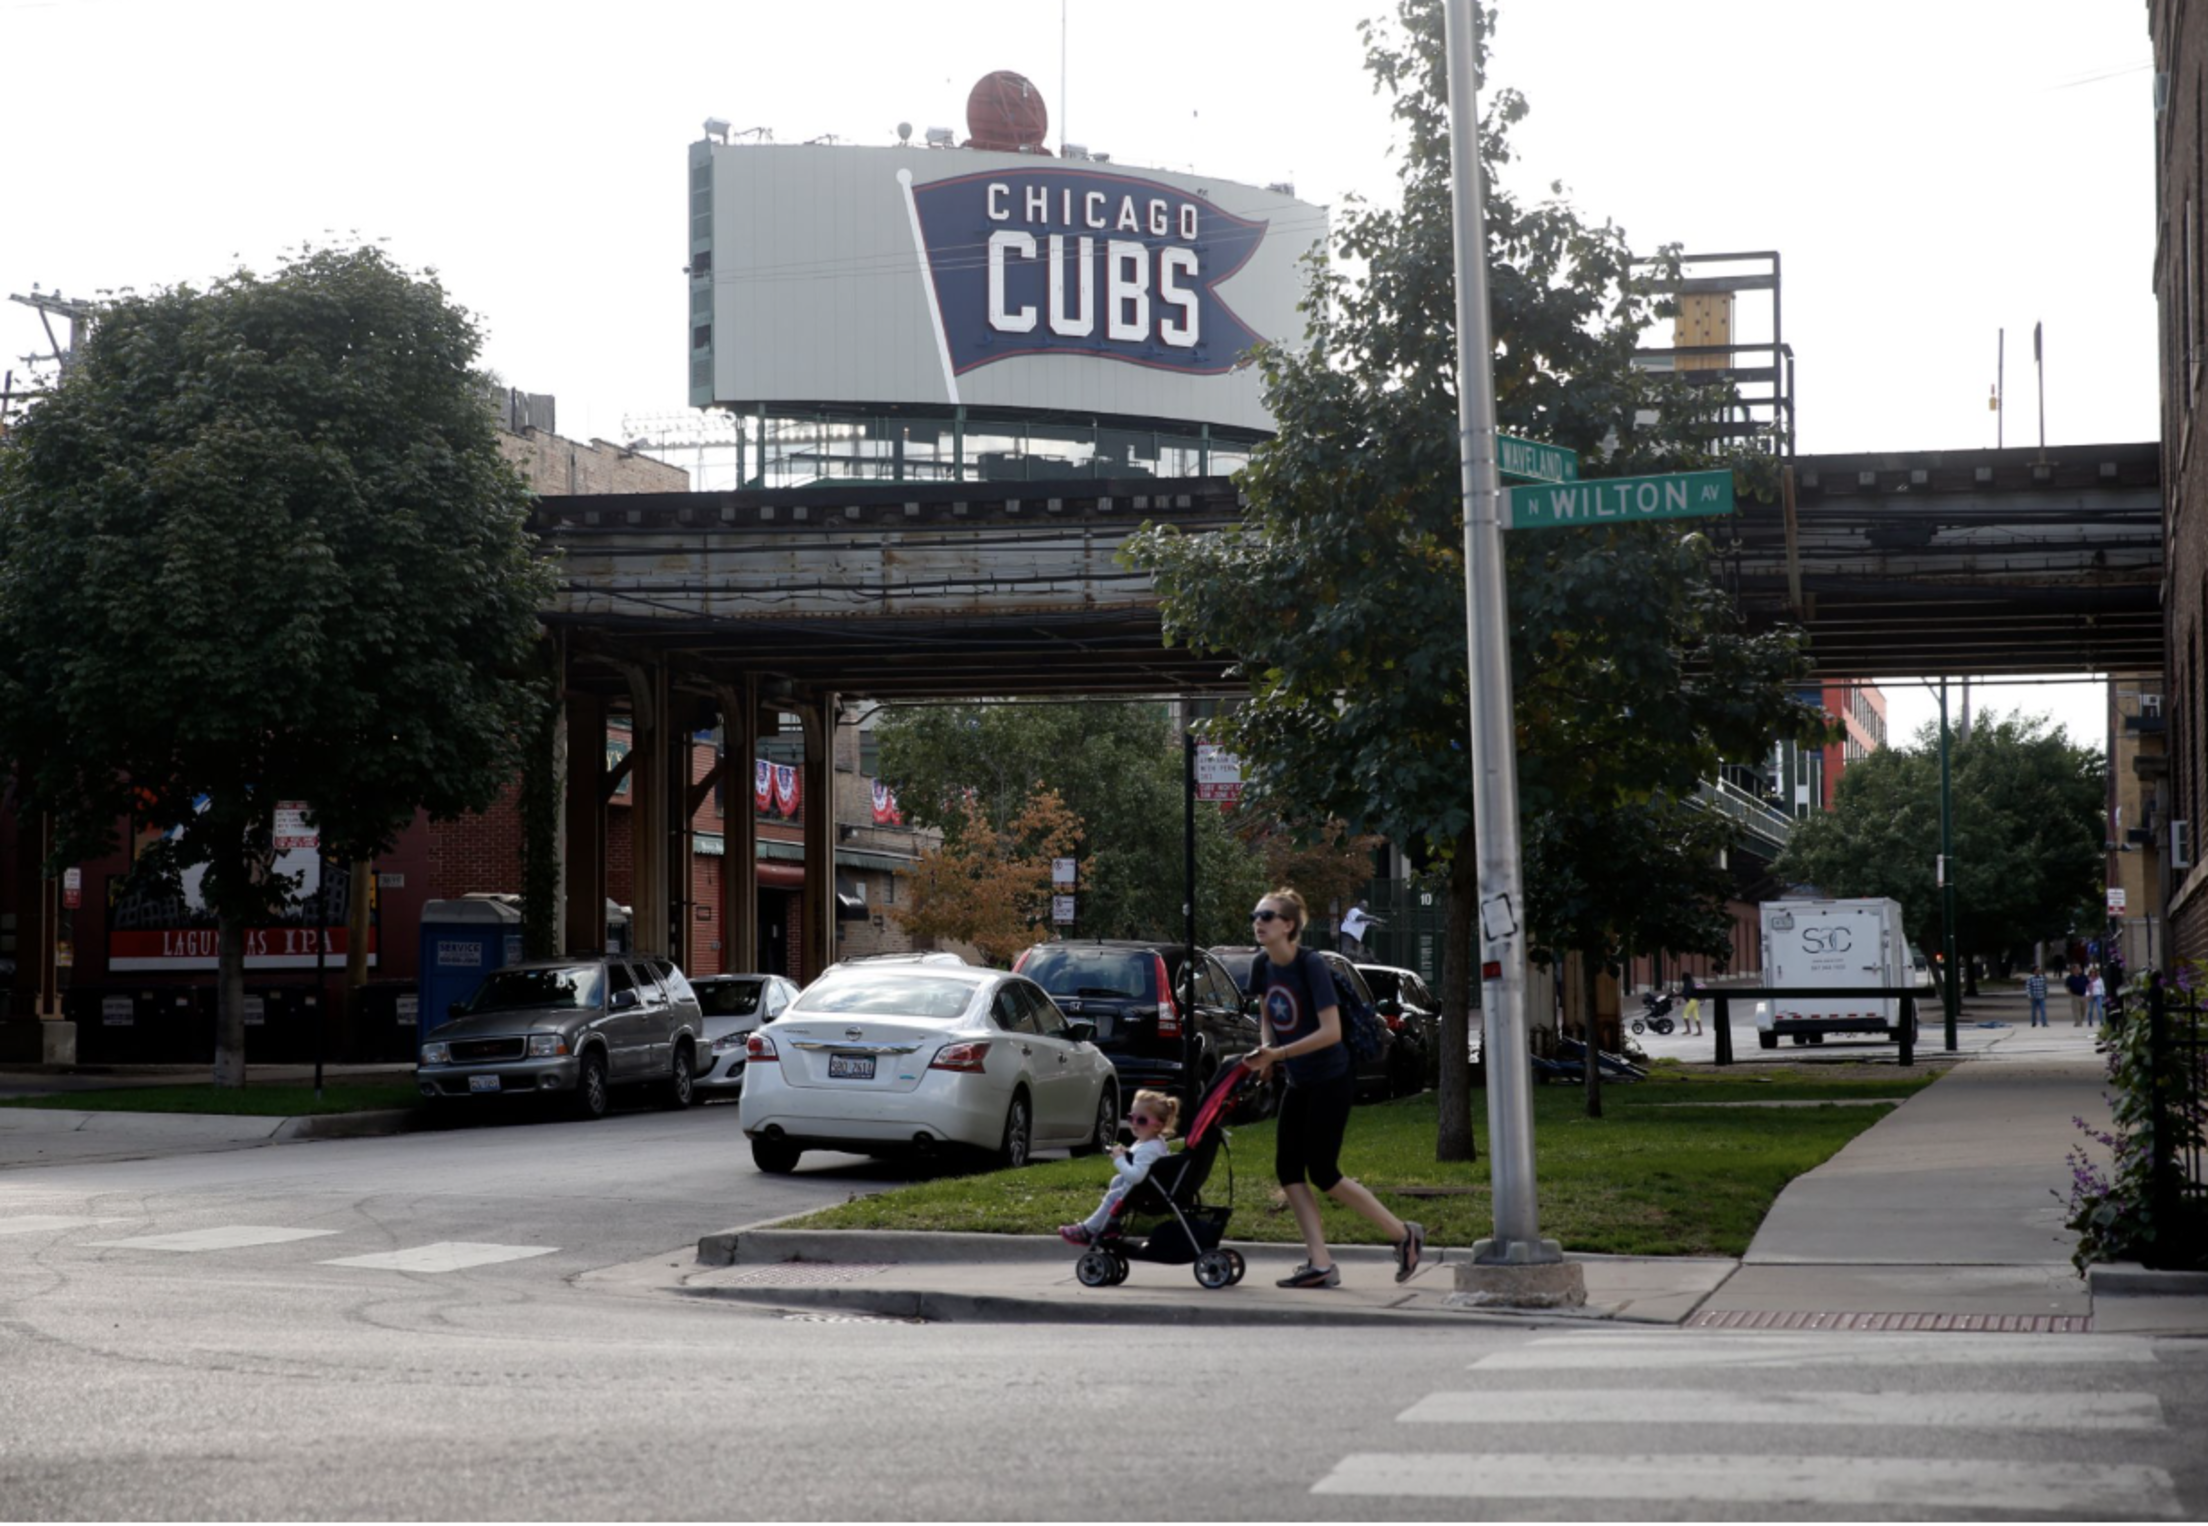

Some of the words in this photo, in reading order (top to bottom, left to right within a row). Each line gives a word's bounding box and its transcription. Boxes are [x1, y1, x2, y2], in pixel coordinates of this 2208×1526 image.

[988, 182, 1198, 241] CHICAGO
[988, 230, 1200, 348] CUBS
[1502, 441, 1562, 480] WAVELAND
[1528, 498, 1539, 515] N
[1551, 479, 1688, 520] WILTON
[1700, 484, 1720, 502] AV
[1420, 893, 1433, 906] 10
[162, 930, 269, 956] LAGUAS
[439, 943, 480, 952] SERVICE
